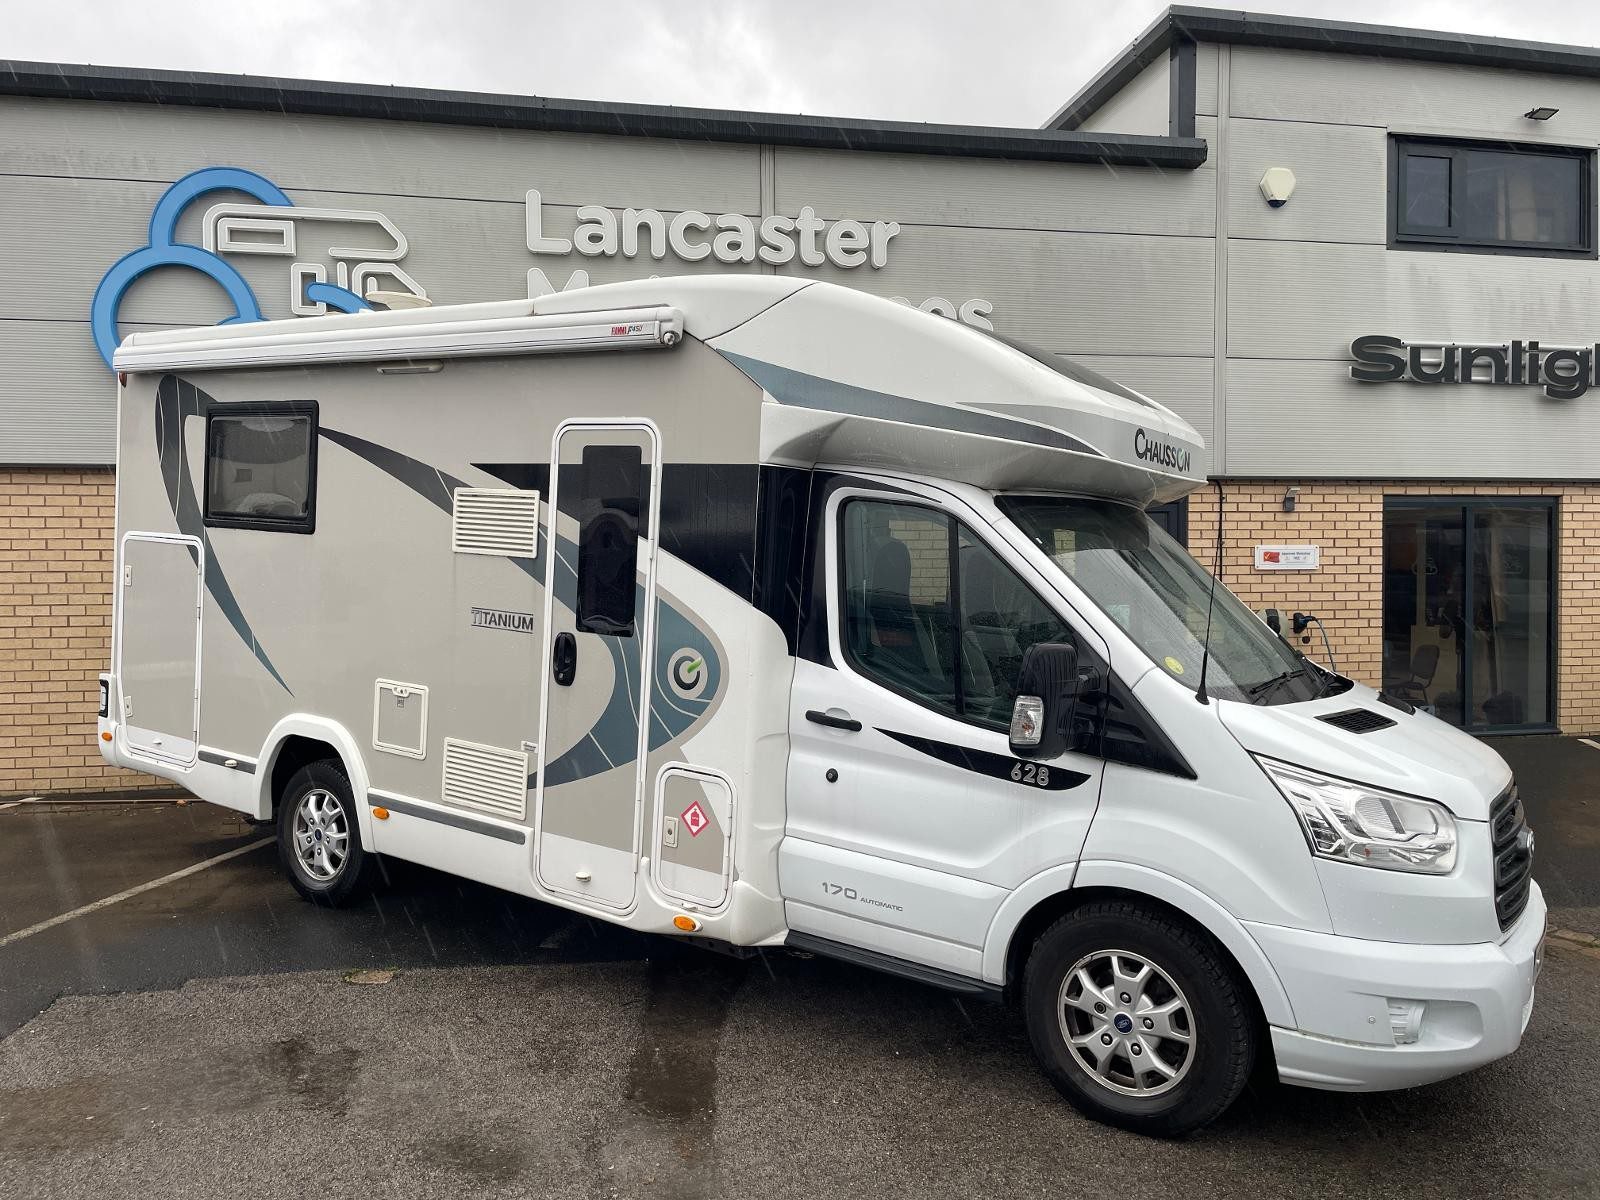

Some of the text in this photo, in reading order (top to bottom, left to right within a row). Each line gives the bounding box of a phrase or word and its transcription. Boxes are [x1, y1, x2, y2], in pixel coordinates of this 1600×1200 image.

[525, 189, 900, 269] Lancaster
[1349, 335, 1600, 399] Sunlig
[471, 609, 534, 631] TITANIUM
[1010, 762, 1049, 786] 628
[822, 882, 904, 912] 170 AUTOMATIC
